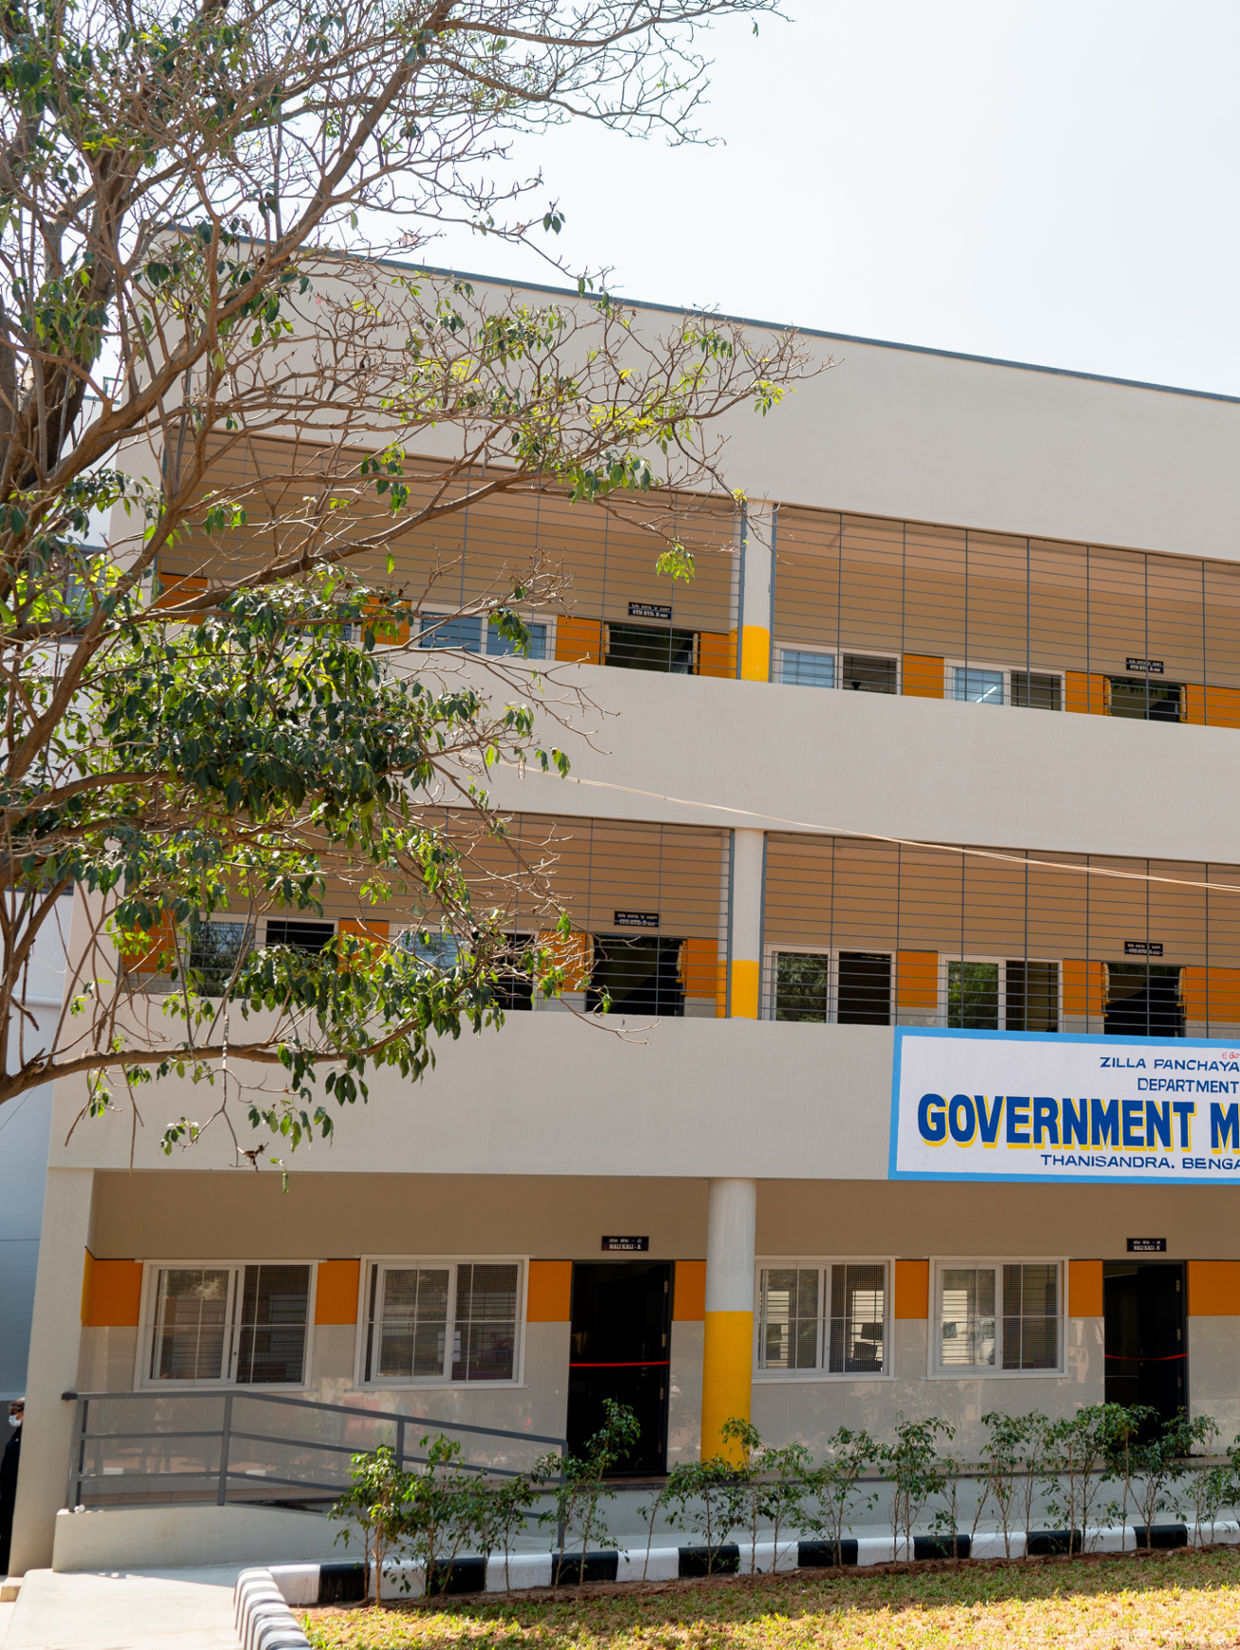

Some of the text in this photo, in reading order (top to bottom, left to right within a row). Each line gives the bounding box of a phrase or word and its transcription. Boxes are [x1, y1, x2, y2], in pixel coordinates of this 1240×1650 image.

[1100, 1057, 1146, 1069] ZILLA
[1137, 1077, 1240, 1094] DEPARTMENT
[917, 1093, 1197, 1152] GOVERNMENT
